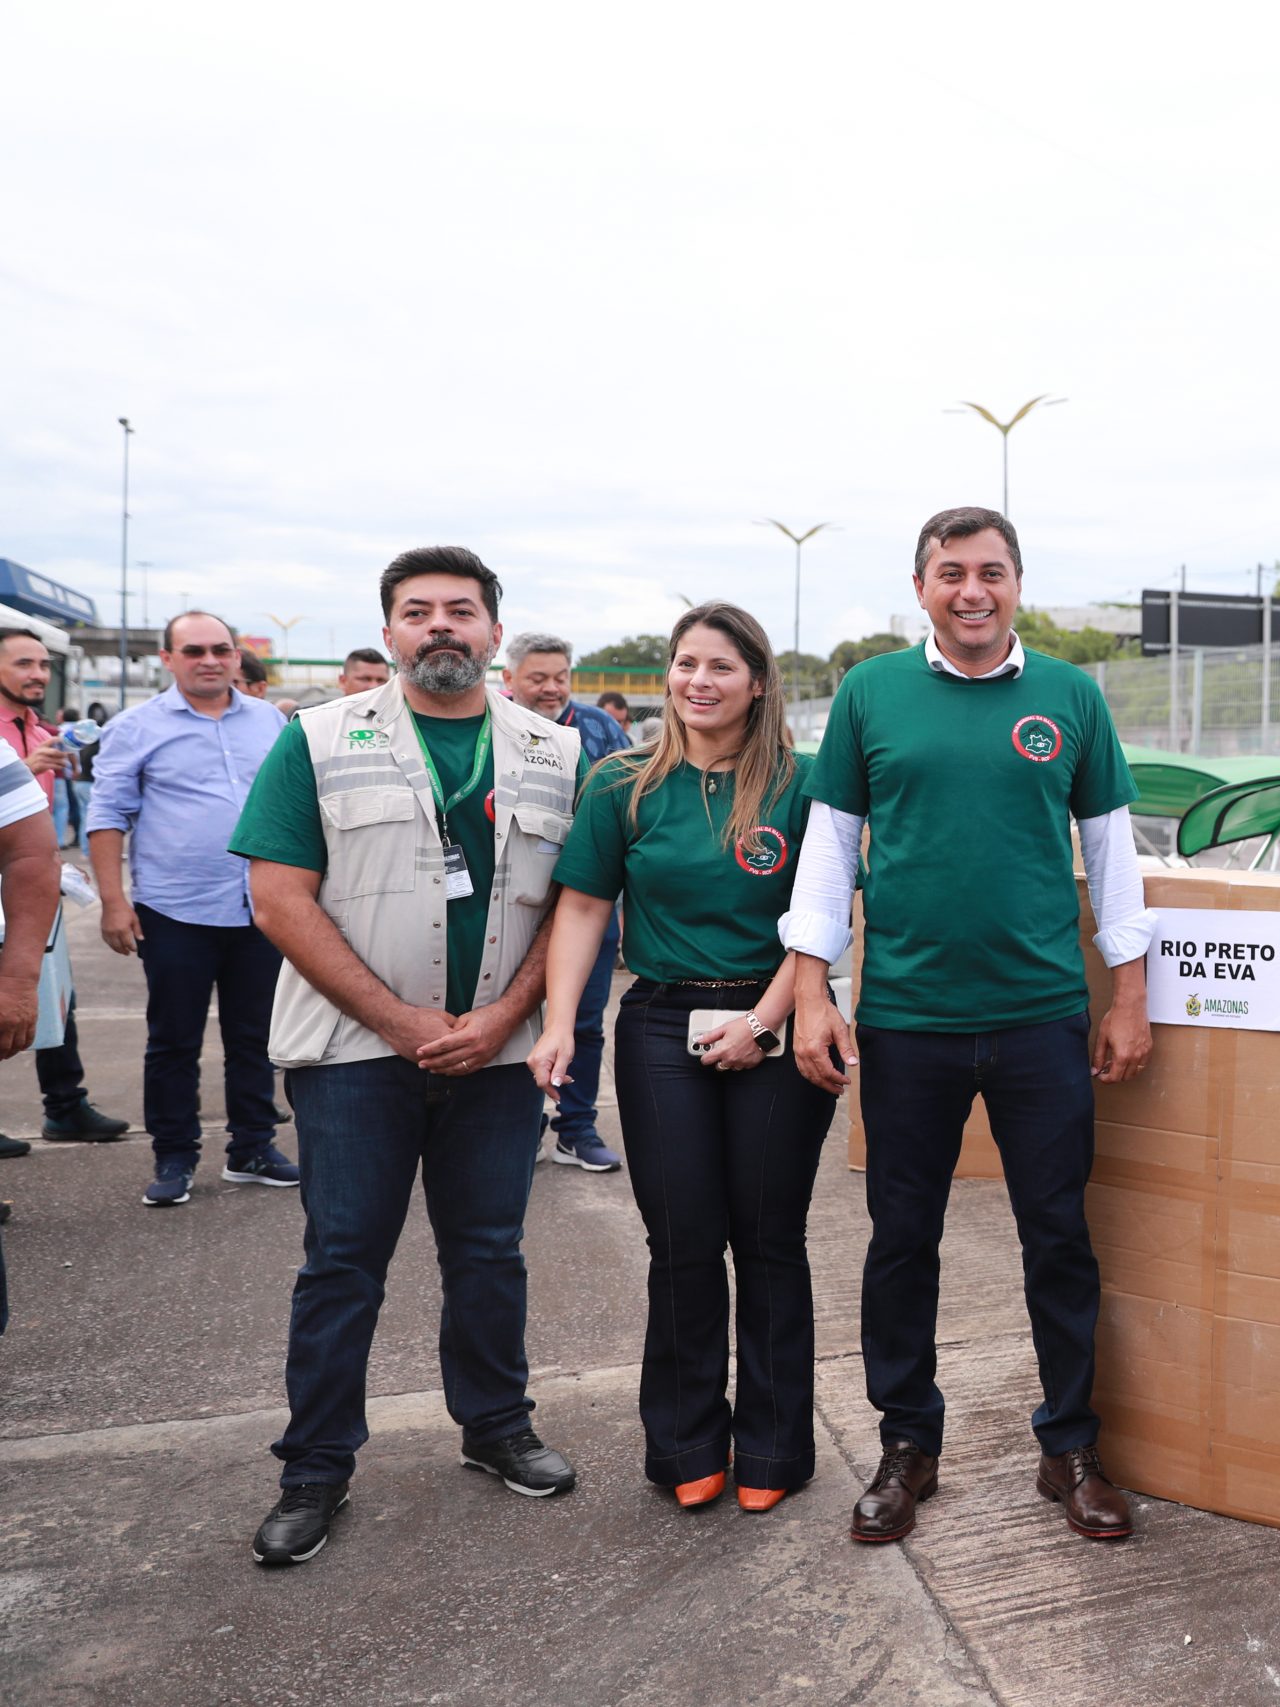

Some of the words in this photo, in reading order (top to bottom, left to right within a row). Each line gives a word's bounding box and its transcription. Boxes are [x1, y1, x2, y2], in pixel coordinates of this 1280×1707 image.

[349, 740, 377, 750] FVS
[1160, 940, 1198, 958] RIO
[1204, 942, 1276, 962] PRETO
[1179, 961, 1207, 978] DA
[1214, 963, 1256, 981] EVA
[1204, 998, 1249, 1015] AMAZONAS
